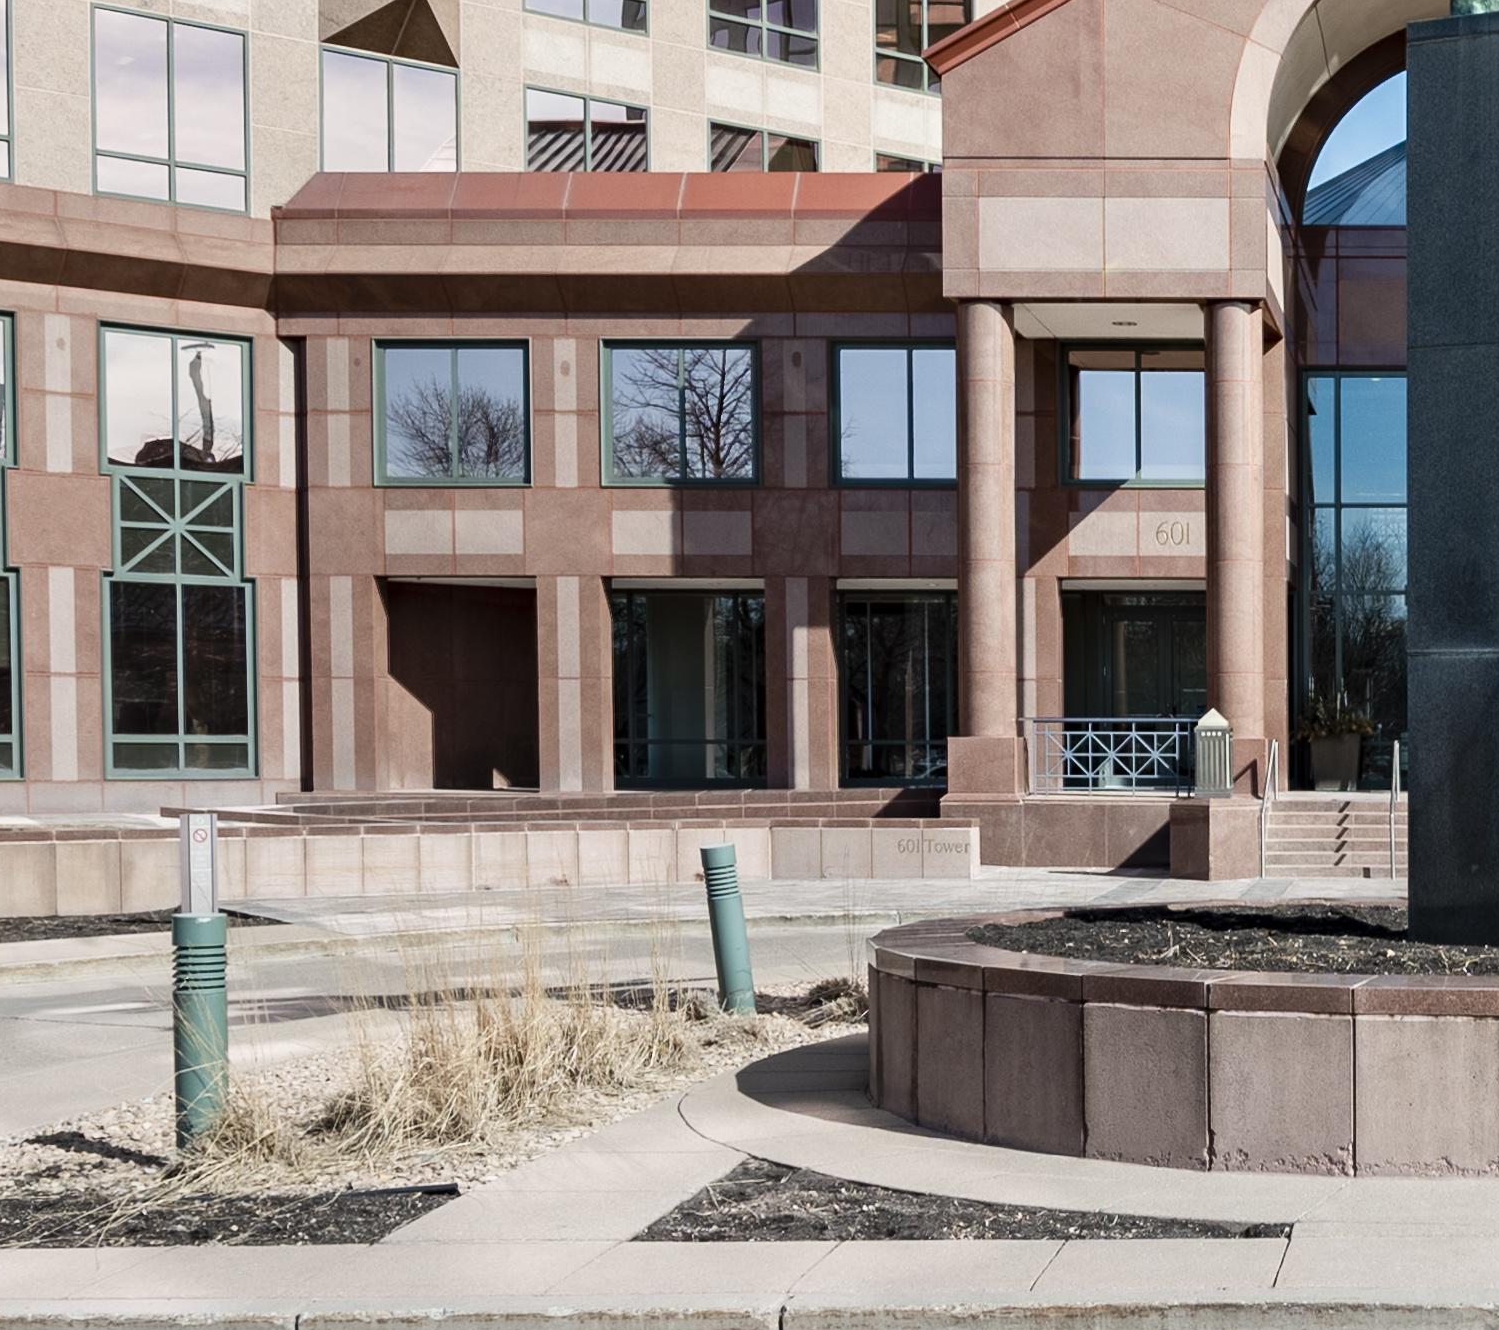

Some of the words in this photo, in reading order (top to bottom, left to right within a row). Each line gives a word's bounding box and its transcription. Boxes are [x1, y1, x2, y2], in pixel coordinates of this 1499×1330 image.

[1155, 520, 1190, 546] 601
[897, 838, 920, 854] 601
[924, 838, 971, 854] Tower
